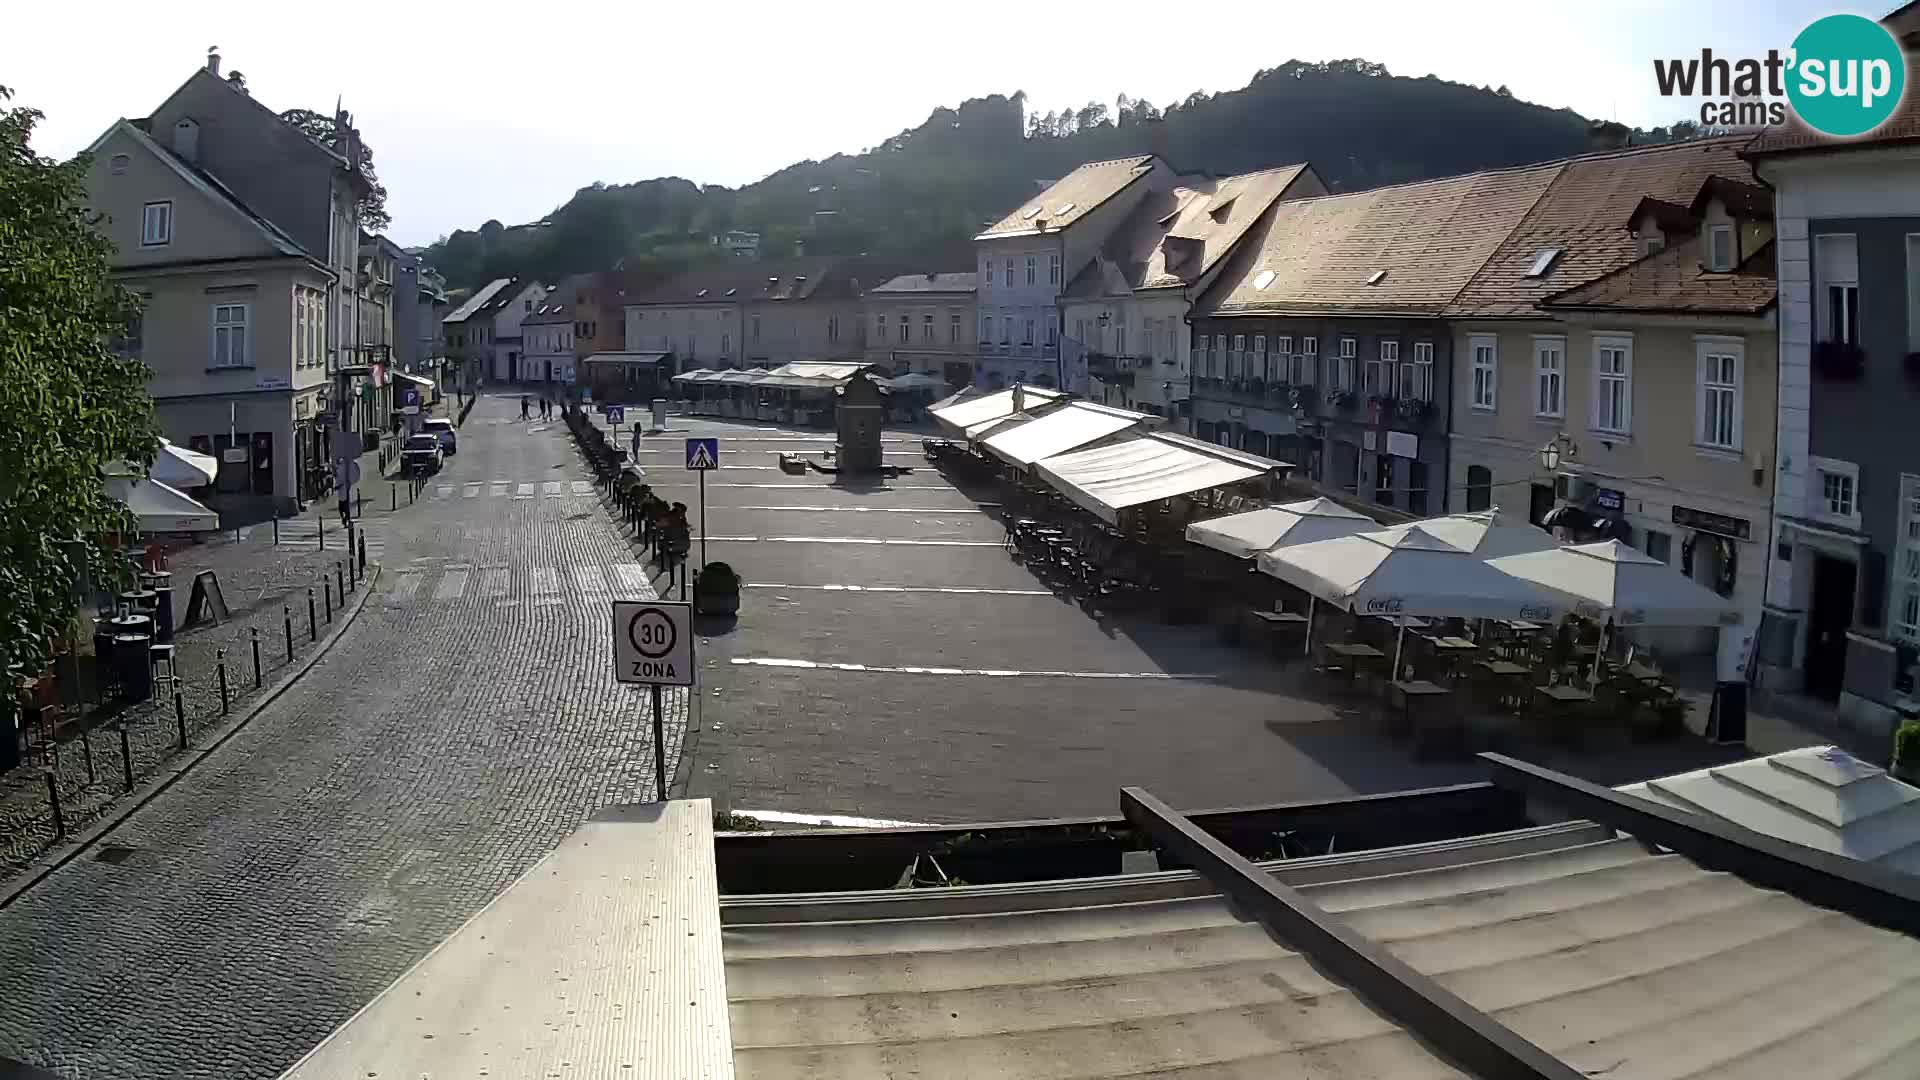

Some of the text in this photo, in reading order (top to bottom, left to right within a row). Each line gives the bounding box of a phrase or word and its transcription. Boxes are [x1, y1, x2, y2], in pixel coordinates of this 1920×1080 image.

[407, 392, 416, 404] P
[641, 624, 666, 645] 30
[632, 661, 676, 678] ZONA
